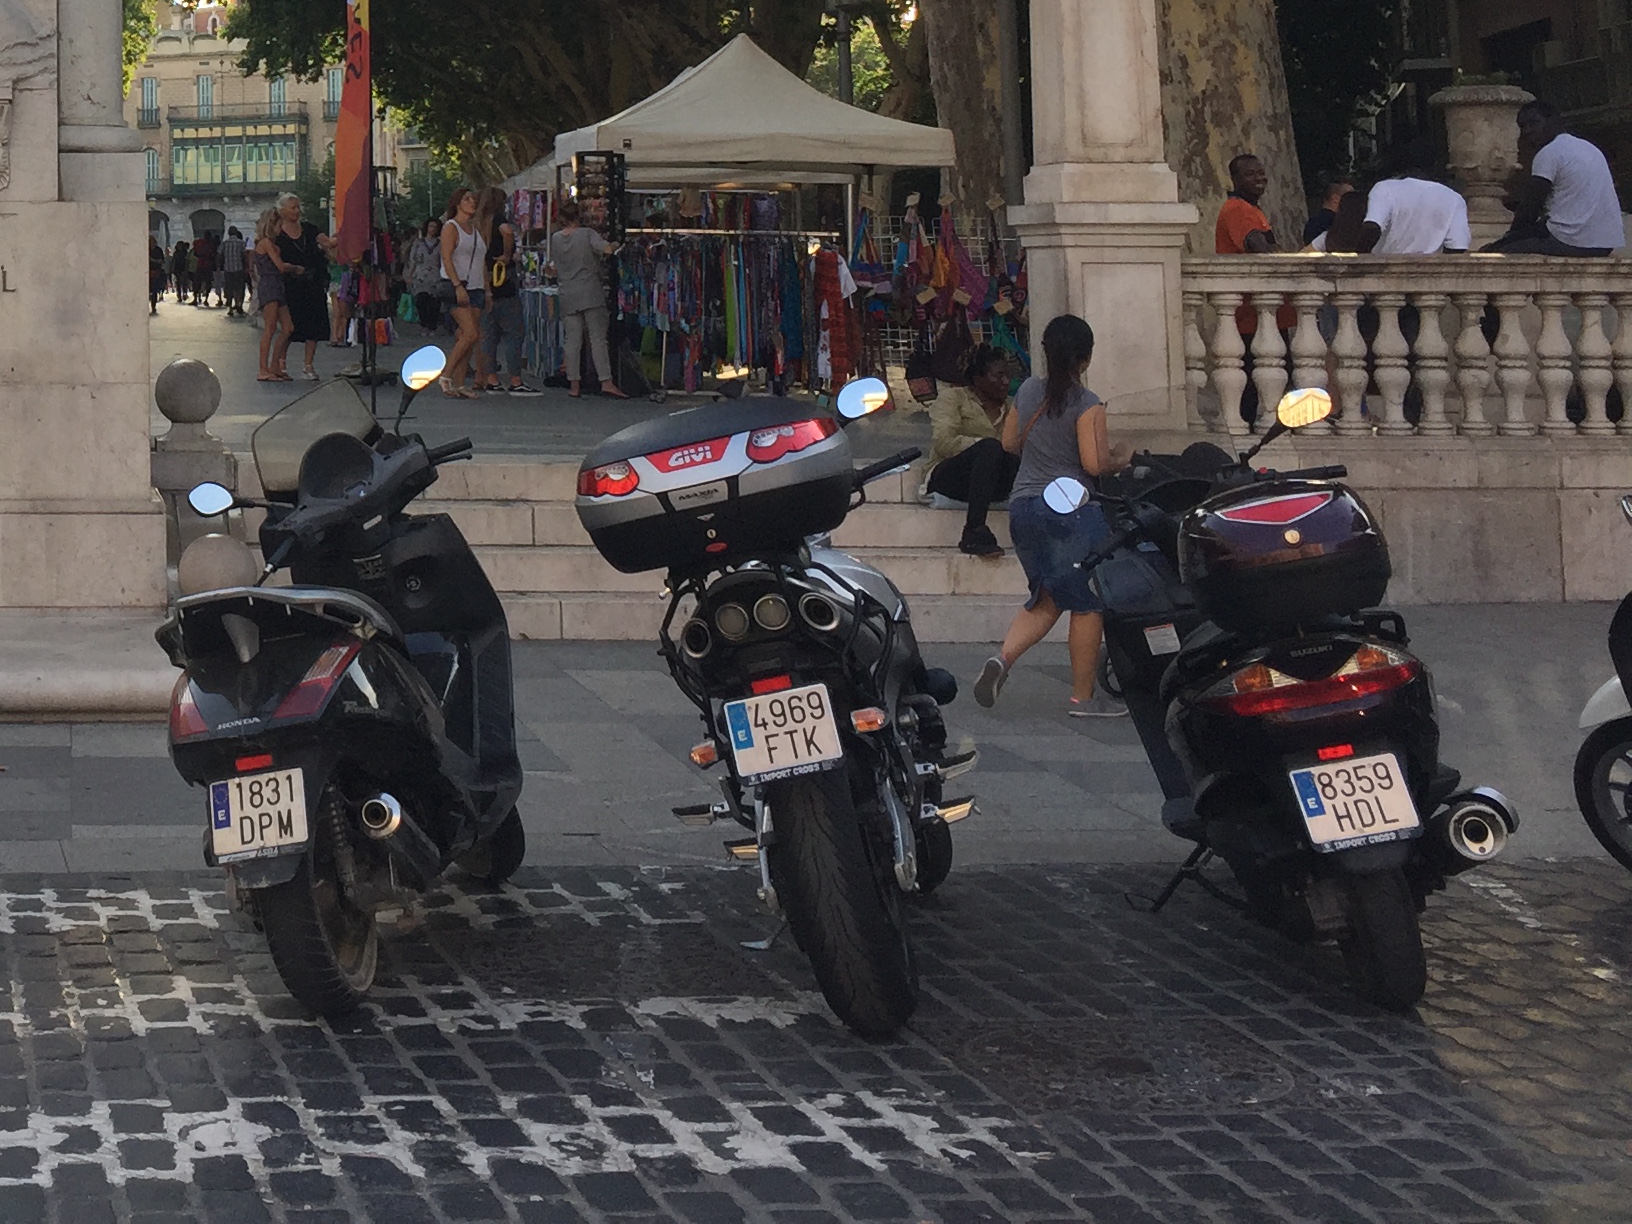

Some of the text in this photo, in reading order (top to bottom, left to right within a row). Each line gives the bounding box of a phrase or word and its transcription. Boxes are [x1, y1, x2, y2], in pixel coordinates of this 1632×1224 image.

[668, 445, 713, 468] GIVI
[1290, 644, 1333, 658] SUZUKI
[753, 690, 826, 731] 4969
[217, 716, 261, 730] HONDA
[764, 725, 823, 764] FTK
[759, 769, 792, 783] IMPORT
[793, 763, 820, 776] CROSS
[1318, 761, 1394, 801] 8359
[235, 774, 295, 811] 1831
[1307, 797, 1319, 809] E
[218, 809, 227, 821] E
[1331, 796, 1400, 833] HDL
[239, 808, 294, 845] DPM
[1333, 836, 1367, 850] IMPORT
[1368, 832, 1397, 845] CROSS
